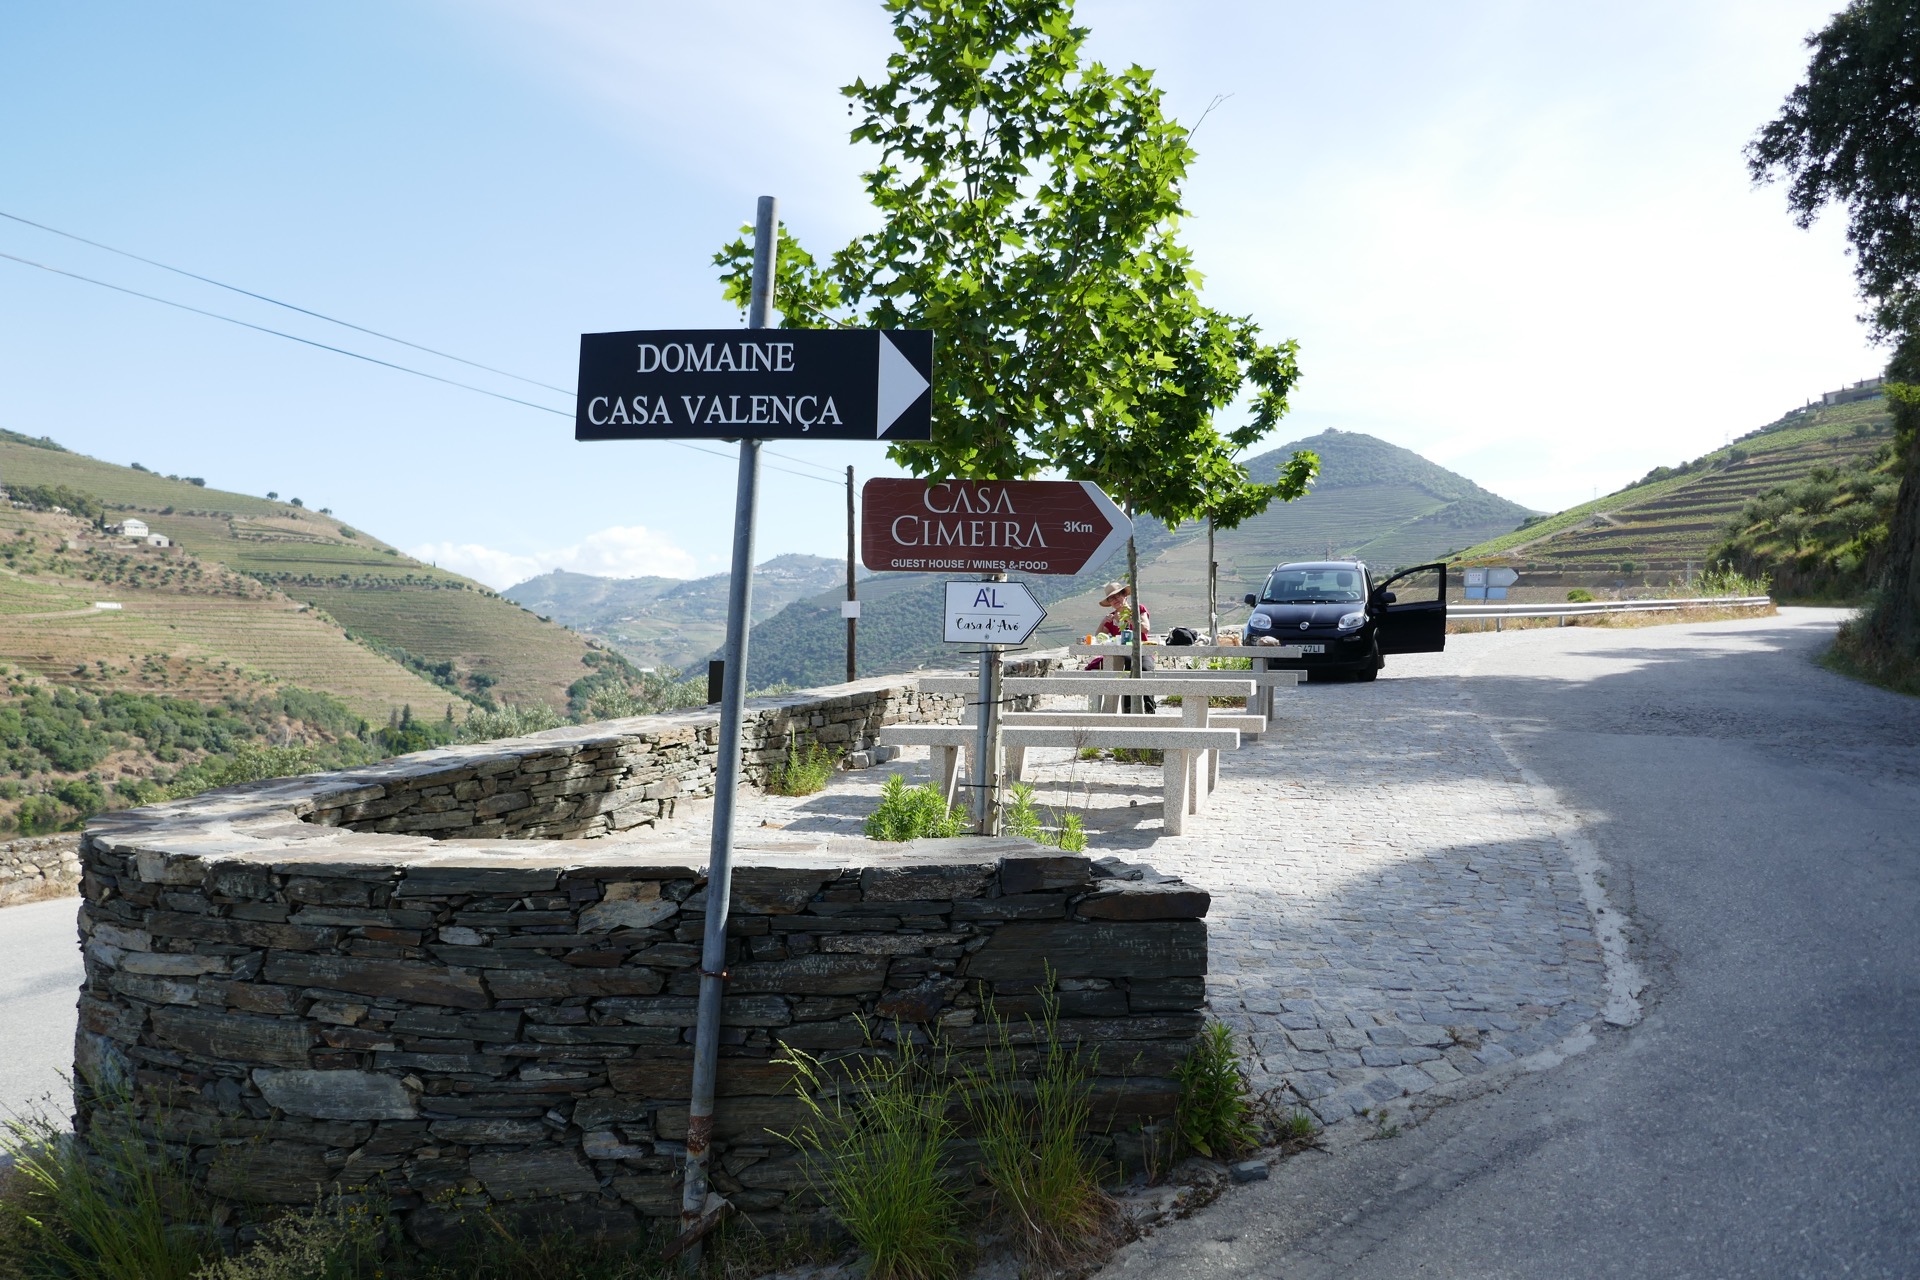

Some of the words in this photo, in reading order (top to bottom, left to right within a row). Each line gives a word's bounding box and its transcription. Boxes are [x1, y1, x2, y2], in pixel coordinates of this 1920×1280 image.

[637, 342, 795, 373] DOMAINE
[587, 395, 673, 426] CASA
[681, 395, 843, 432] VALENÇA
[924, 483, 1016, 514] CASA
[891, 515, 1048, 547] CIMEIRA
[1063, 521, 1093, 533] 3Km
[891, 559, 926, 568] GUEST
[928, 559, 964, 569] HOUSE
[973, 560, 1006, 570] WINES
[1018, 560, 1048, 571] FOOD
[973, 588, 1005, 608] AL
[956, 617, 982, 630] Casa
